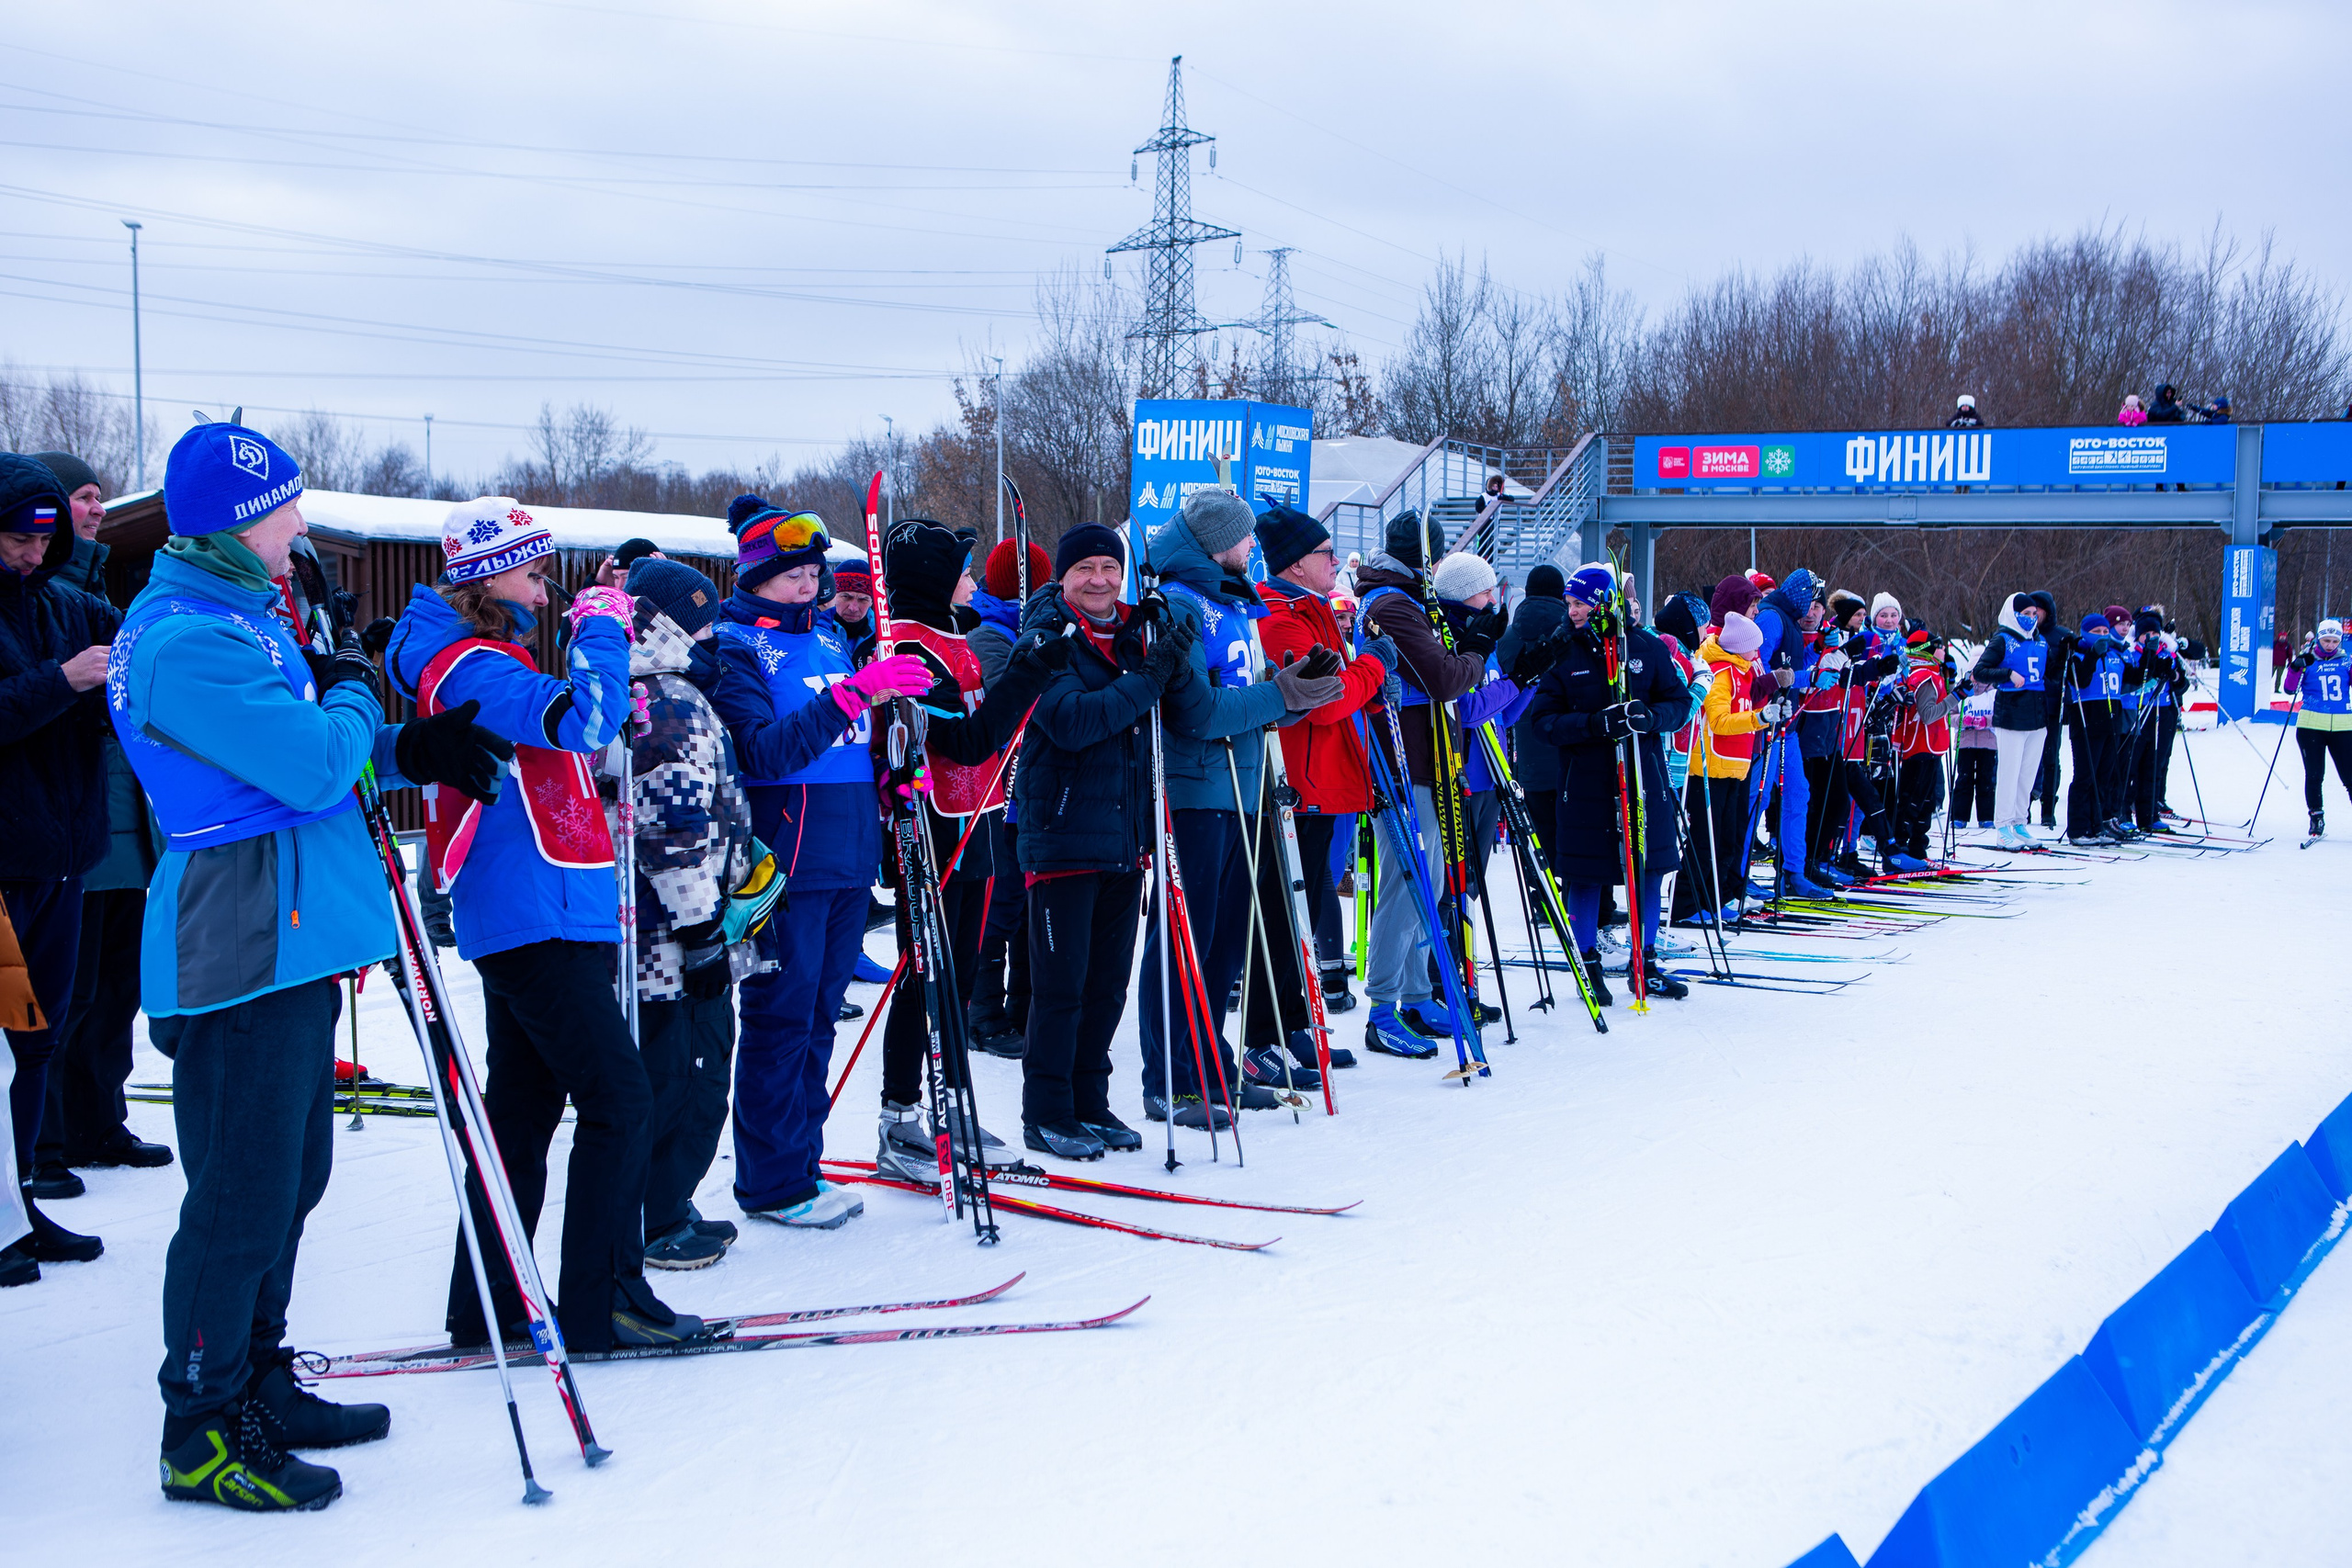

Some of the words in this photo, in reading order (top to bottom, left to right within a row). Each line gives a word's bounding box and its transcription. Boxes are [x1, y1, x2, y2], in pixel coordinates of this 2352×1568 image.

[1137, 419, 1242, 461] ФИНИШ
[1275, 439, 1294, 454] ЛЫЖНЯ
[1276, 424, 1310, 442] МОСКОВСКАЯ
[2070, 436, 2166, 449] ЮГО-ВОСТОК
[1255, 465, 1300, 479] ЮГО-ВОСТОК
[1702, 452, 1749, 465] ЗИМА
[1702, 465, 1709, 473] В
[1711, 464, 1749, 473] МОСКВЕ
[1846, 434, 1992, 482] ФИНИШ
[234, 470, 303, 521] ДИНАМО
[473, 536, 555, 575] ЛЫЖНЯ
[868, 513, 893, 637] BRADOS
[2027, 656, 2041, 682] 5
[2100, 672, 2120, 695] 19
[2318, 674, 2343, 702] 13
[1436, 781, 1451, 862] SALOMON
[1451, 775, 1465, 858] SALOMON
[1508, 796, 1524, 828] NORDWAY
[1636, 796, 1645, 854] FISCHER
[1165, 831, 1183, 890] ATOMIC
[1897, 871, 1938, 879] BRADOS
[900, 818, 922, 942] BRADOS
[1045, 908, 1055, 953] SALOMON
[1376, 1028, 1428, 1054] SPINE
[932, 1057, 948, 1130] ACTIVE
[940, 1139, 951, 1167] A3
[993, 1171, 1050, 1187] ATOMIC
[944, 1179, 956, 1212] 180
[187, 1363, 201, 1382] DO
